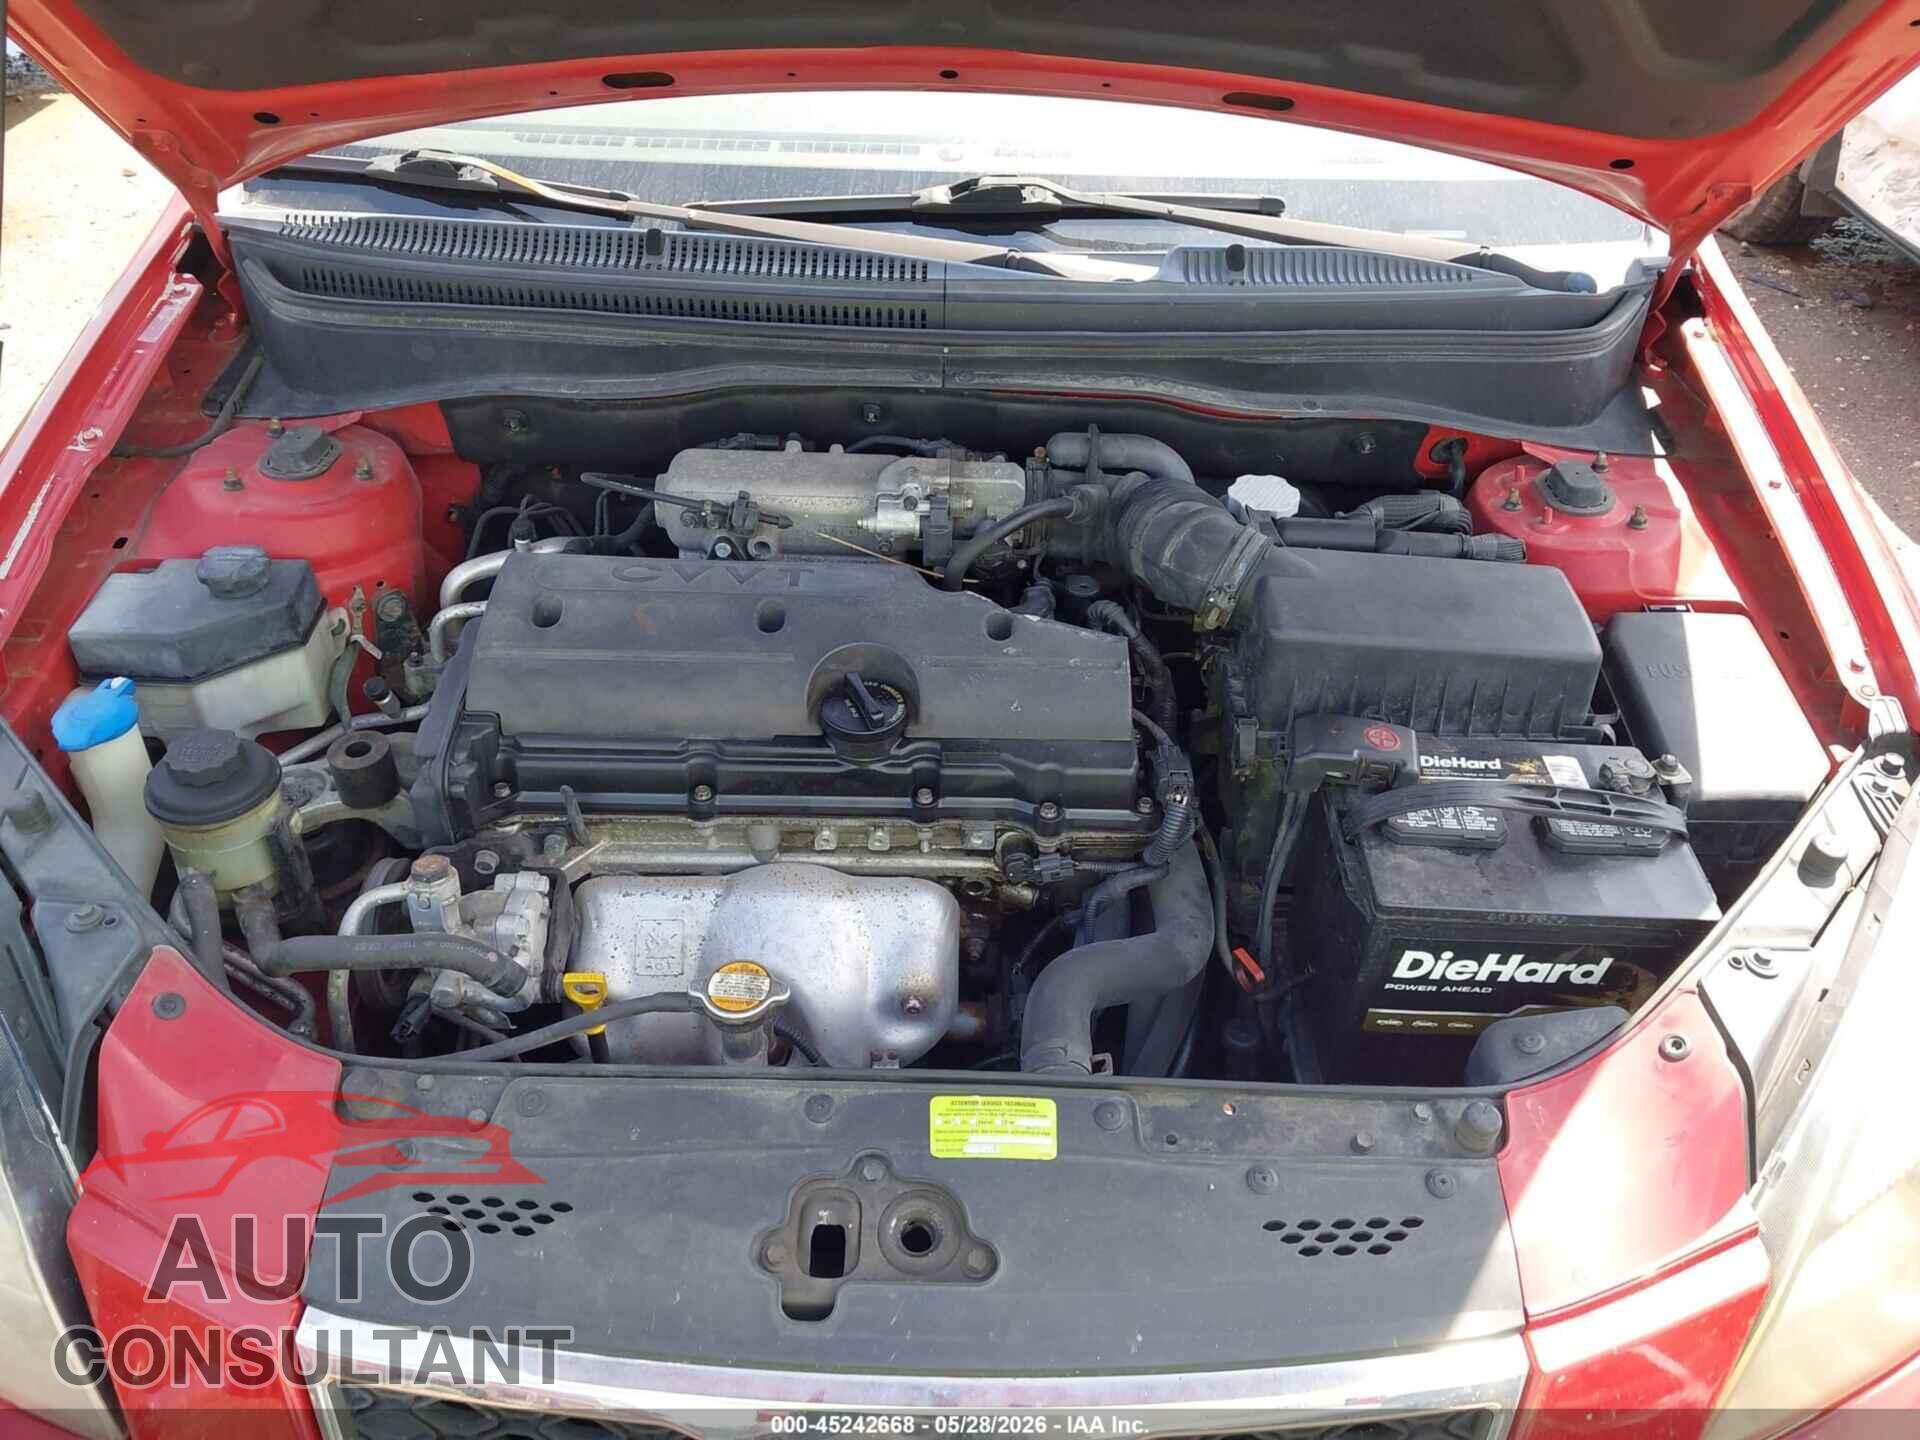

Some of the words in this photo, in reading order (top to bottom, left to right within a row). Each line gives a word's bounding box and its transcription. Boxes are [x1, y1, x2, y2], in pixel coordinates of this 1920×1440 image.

[611, 564, 816, 588] CVVT
[1419, 755, 1502, 770] DieHard
[1392, 949, 1615, 985] DieHard
[1384, 983, 1437, 992] POWER
[1441, 984, 1493, 994] AHEAD
